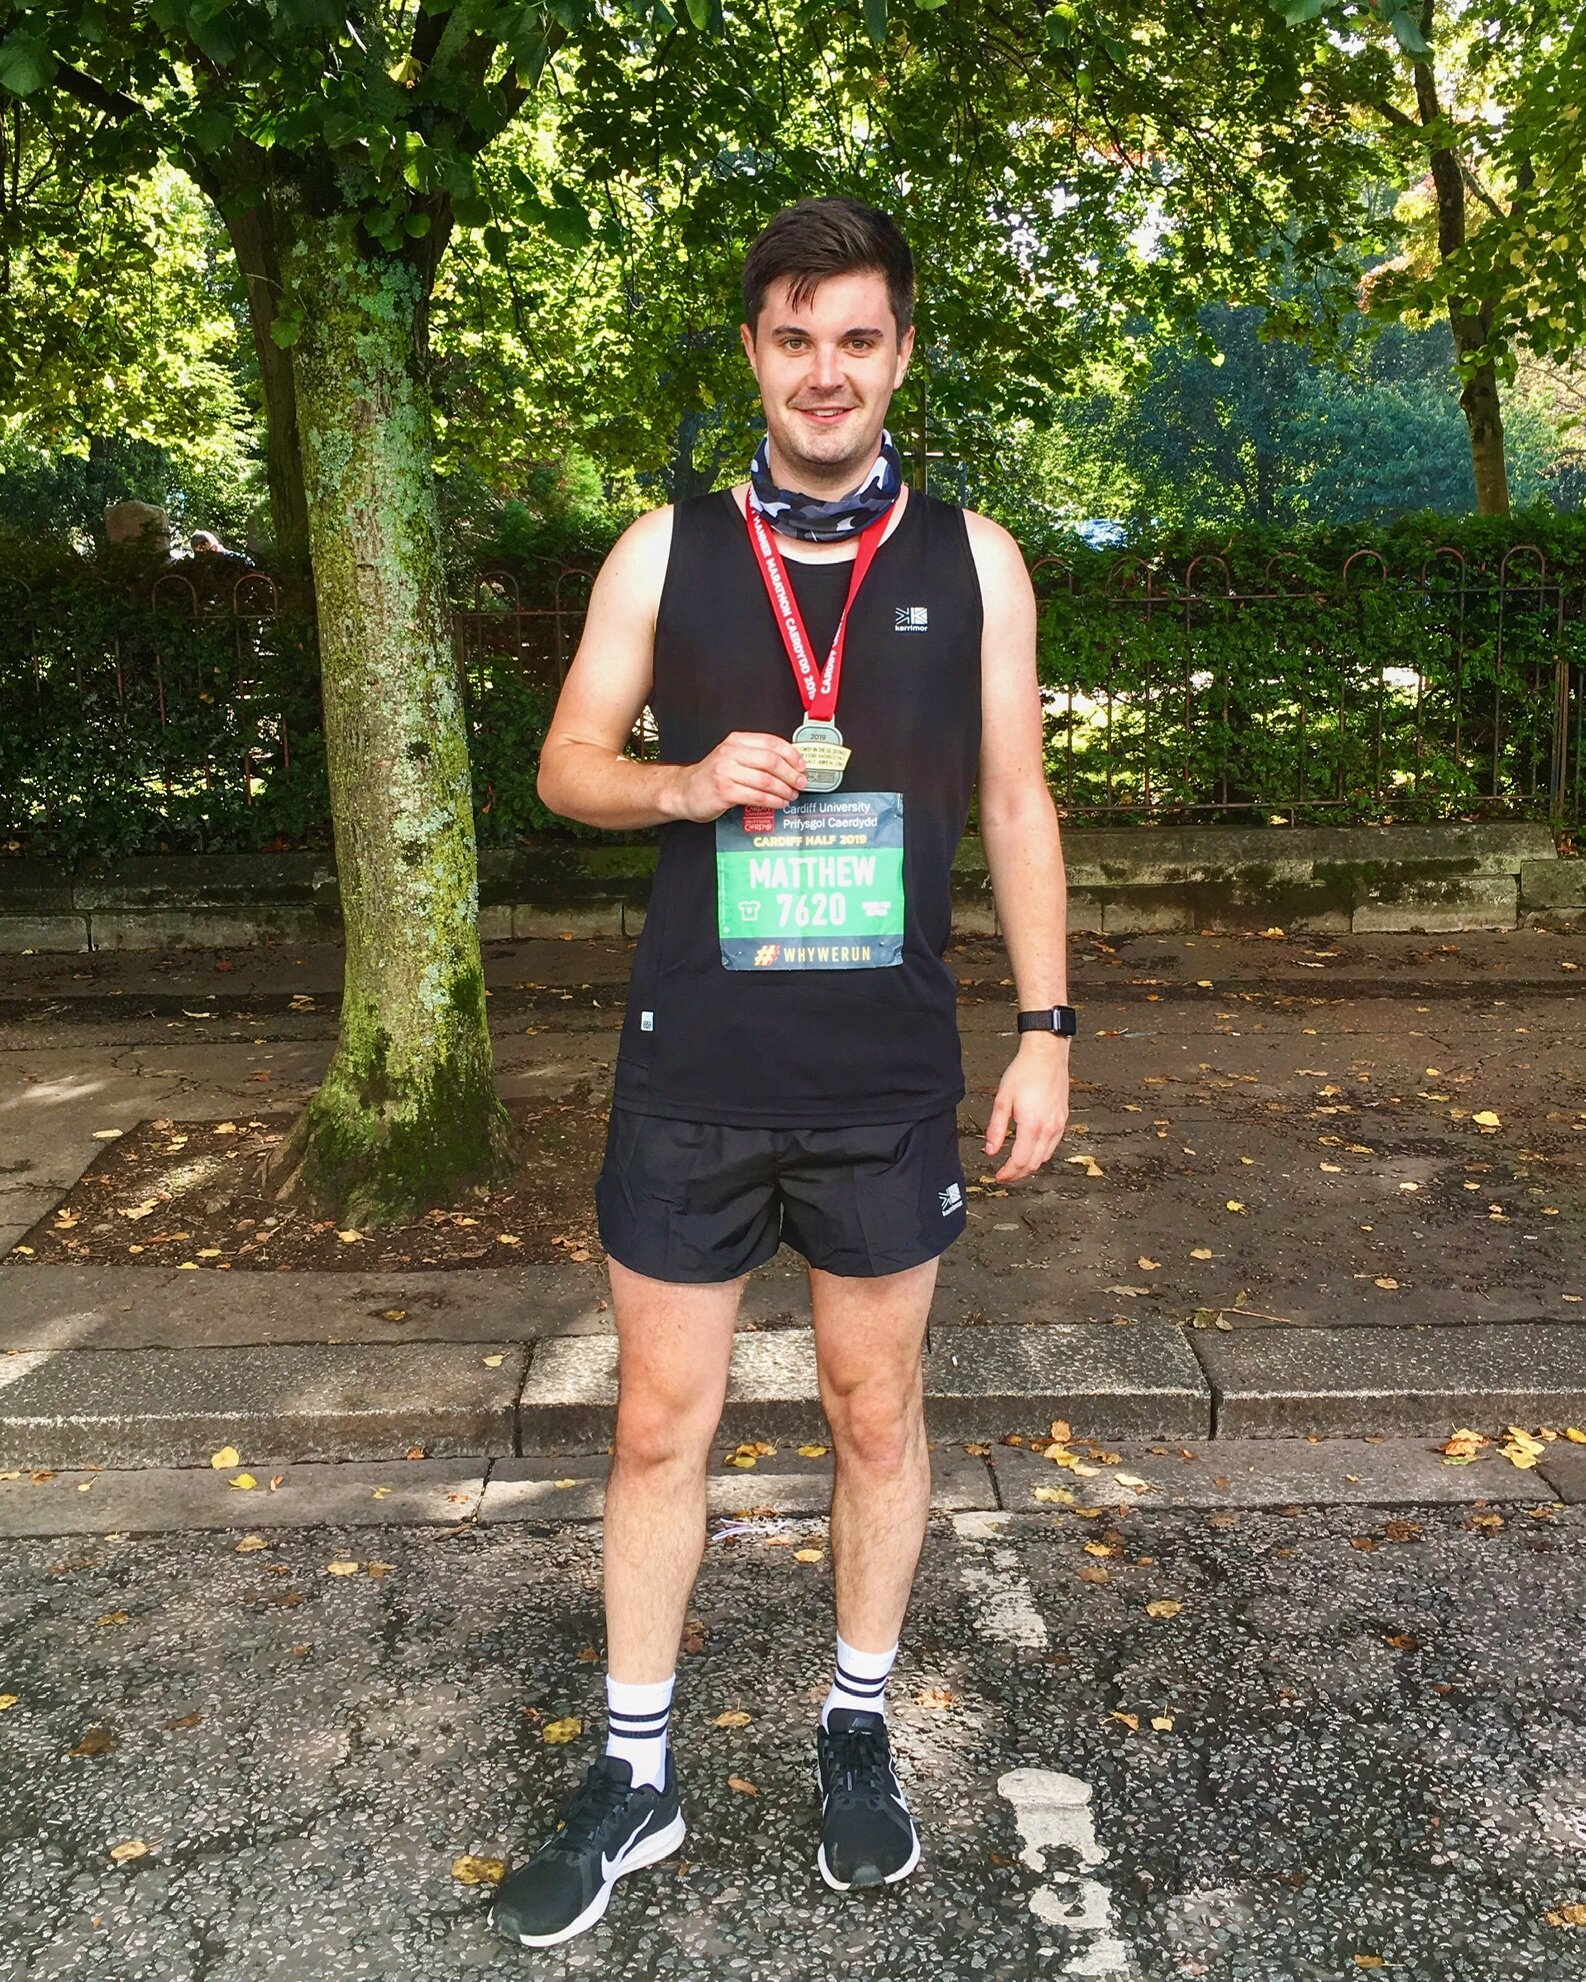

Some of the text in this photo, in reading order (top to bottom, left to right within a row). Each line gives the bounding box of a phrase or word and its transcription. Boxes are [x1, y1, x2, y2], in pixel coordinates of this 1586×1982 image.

[753, 515, 772, 558] HANNER
[766, 557, 792, 617] MARATHON
[785, 617, 811, 674] CAERDYDD
[895, 624, 928, 632] karrimor
[783, 802, 817, 814] Cardiff
[819, 801, 871, 814] University
[783, 817, 878, 831] Prifysgol Caerdydd
[753, 834, 868, 848] CARDIFF HALF 2019
[749, 856, 876, 889] MATTHEW
[776, 892, 847, 928] 7620
